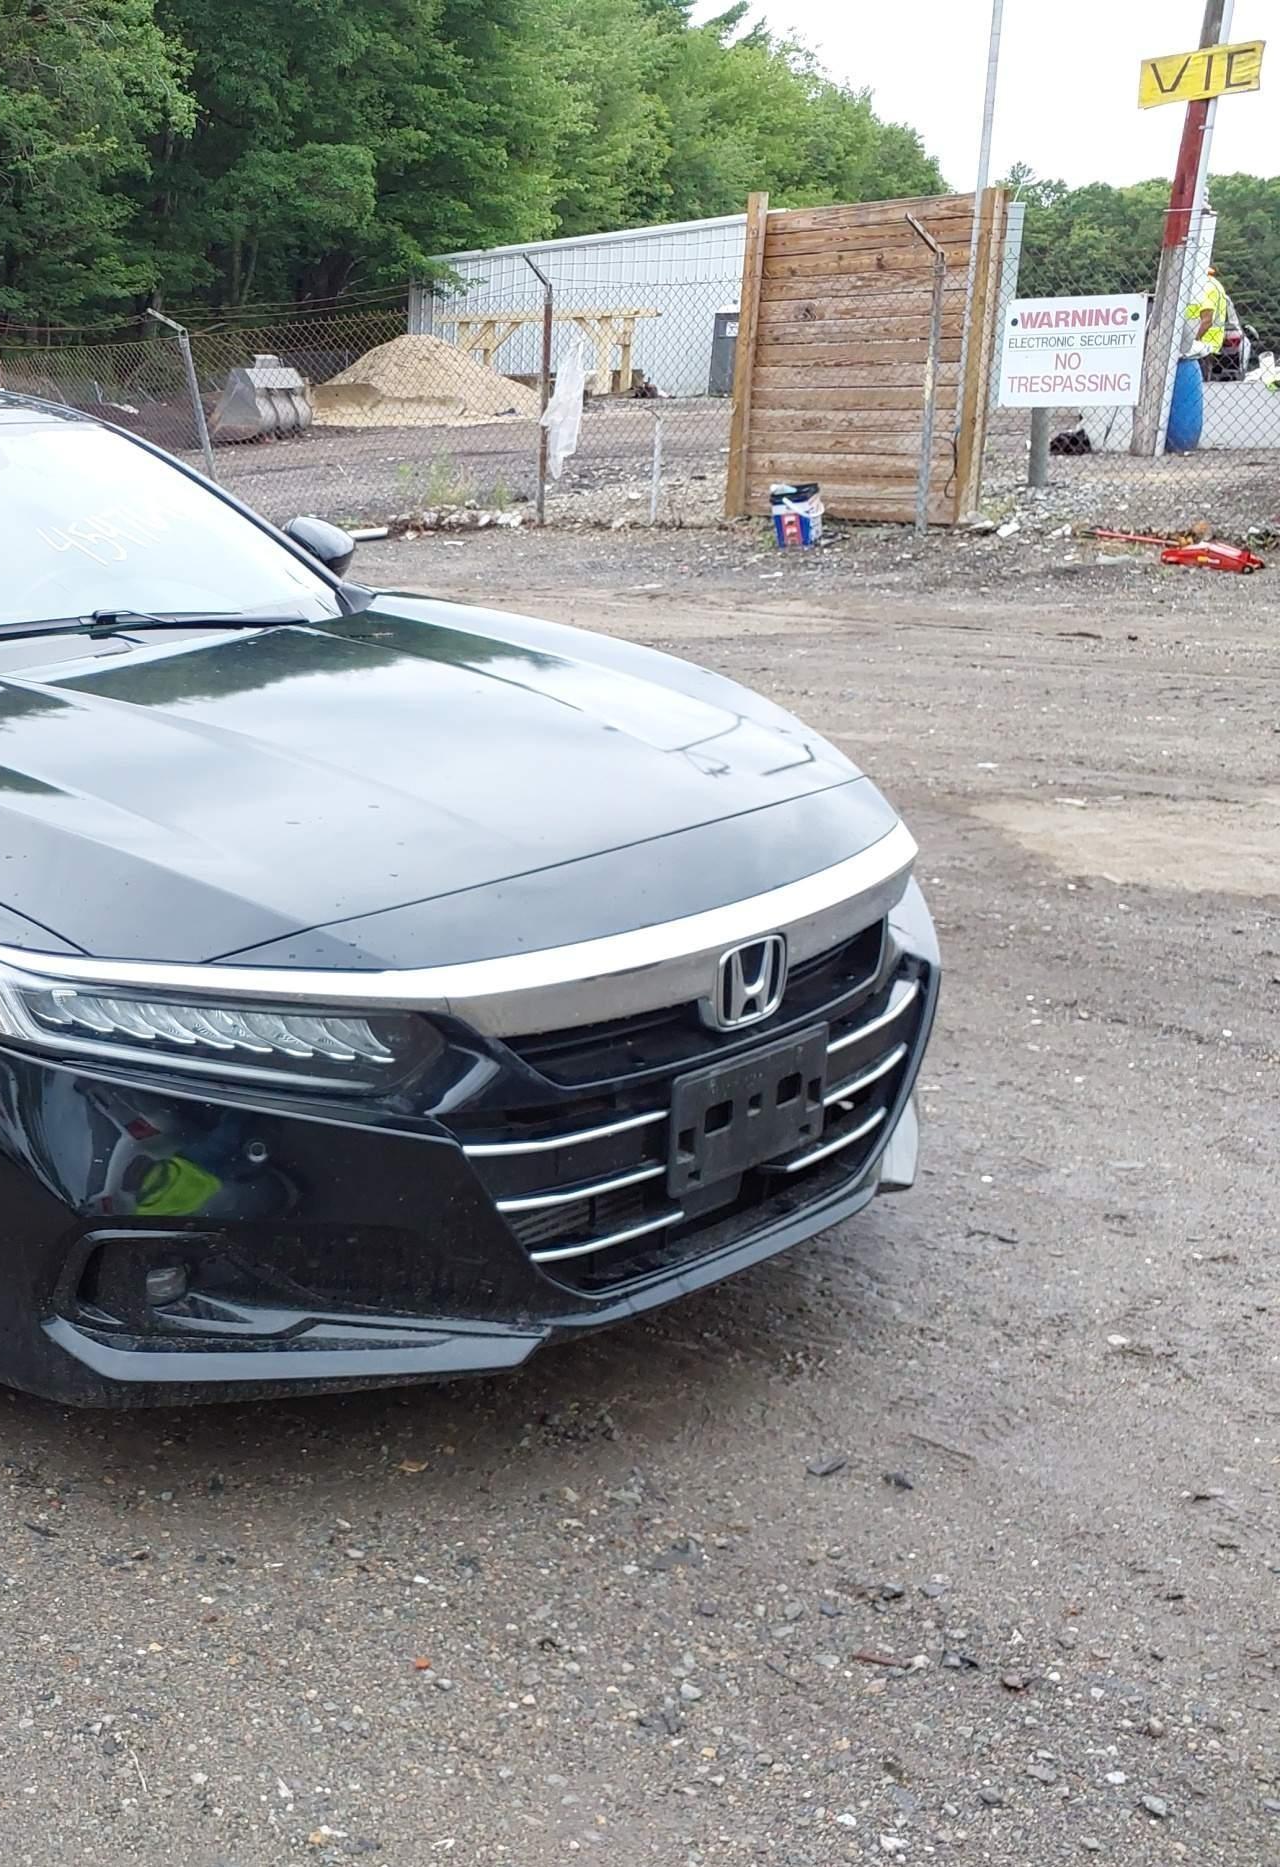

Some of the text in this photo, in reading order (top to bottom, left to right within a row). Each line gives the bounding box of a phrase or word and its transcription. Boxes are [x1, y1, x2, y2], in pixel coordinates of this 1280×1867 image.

[1019, 307, 1129, 329] WARNING
[1008, 334, 1136, 349] ELECTRONIC SECURITY
[1054, 352, 1082, 371] NO
[1007, 373, 1131, 393] TRESPASSING
